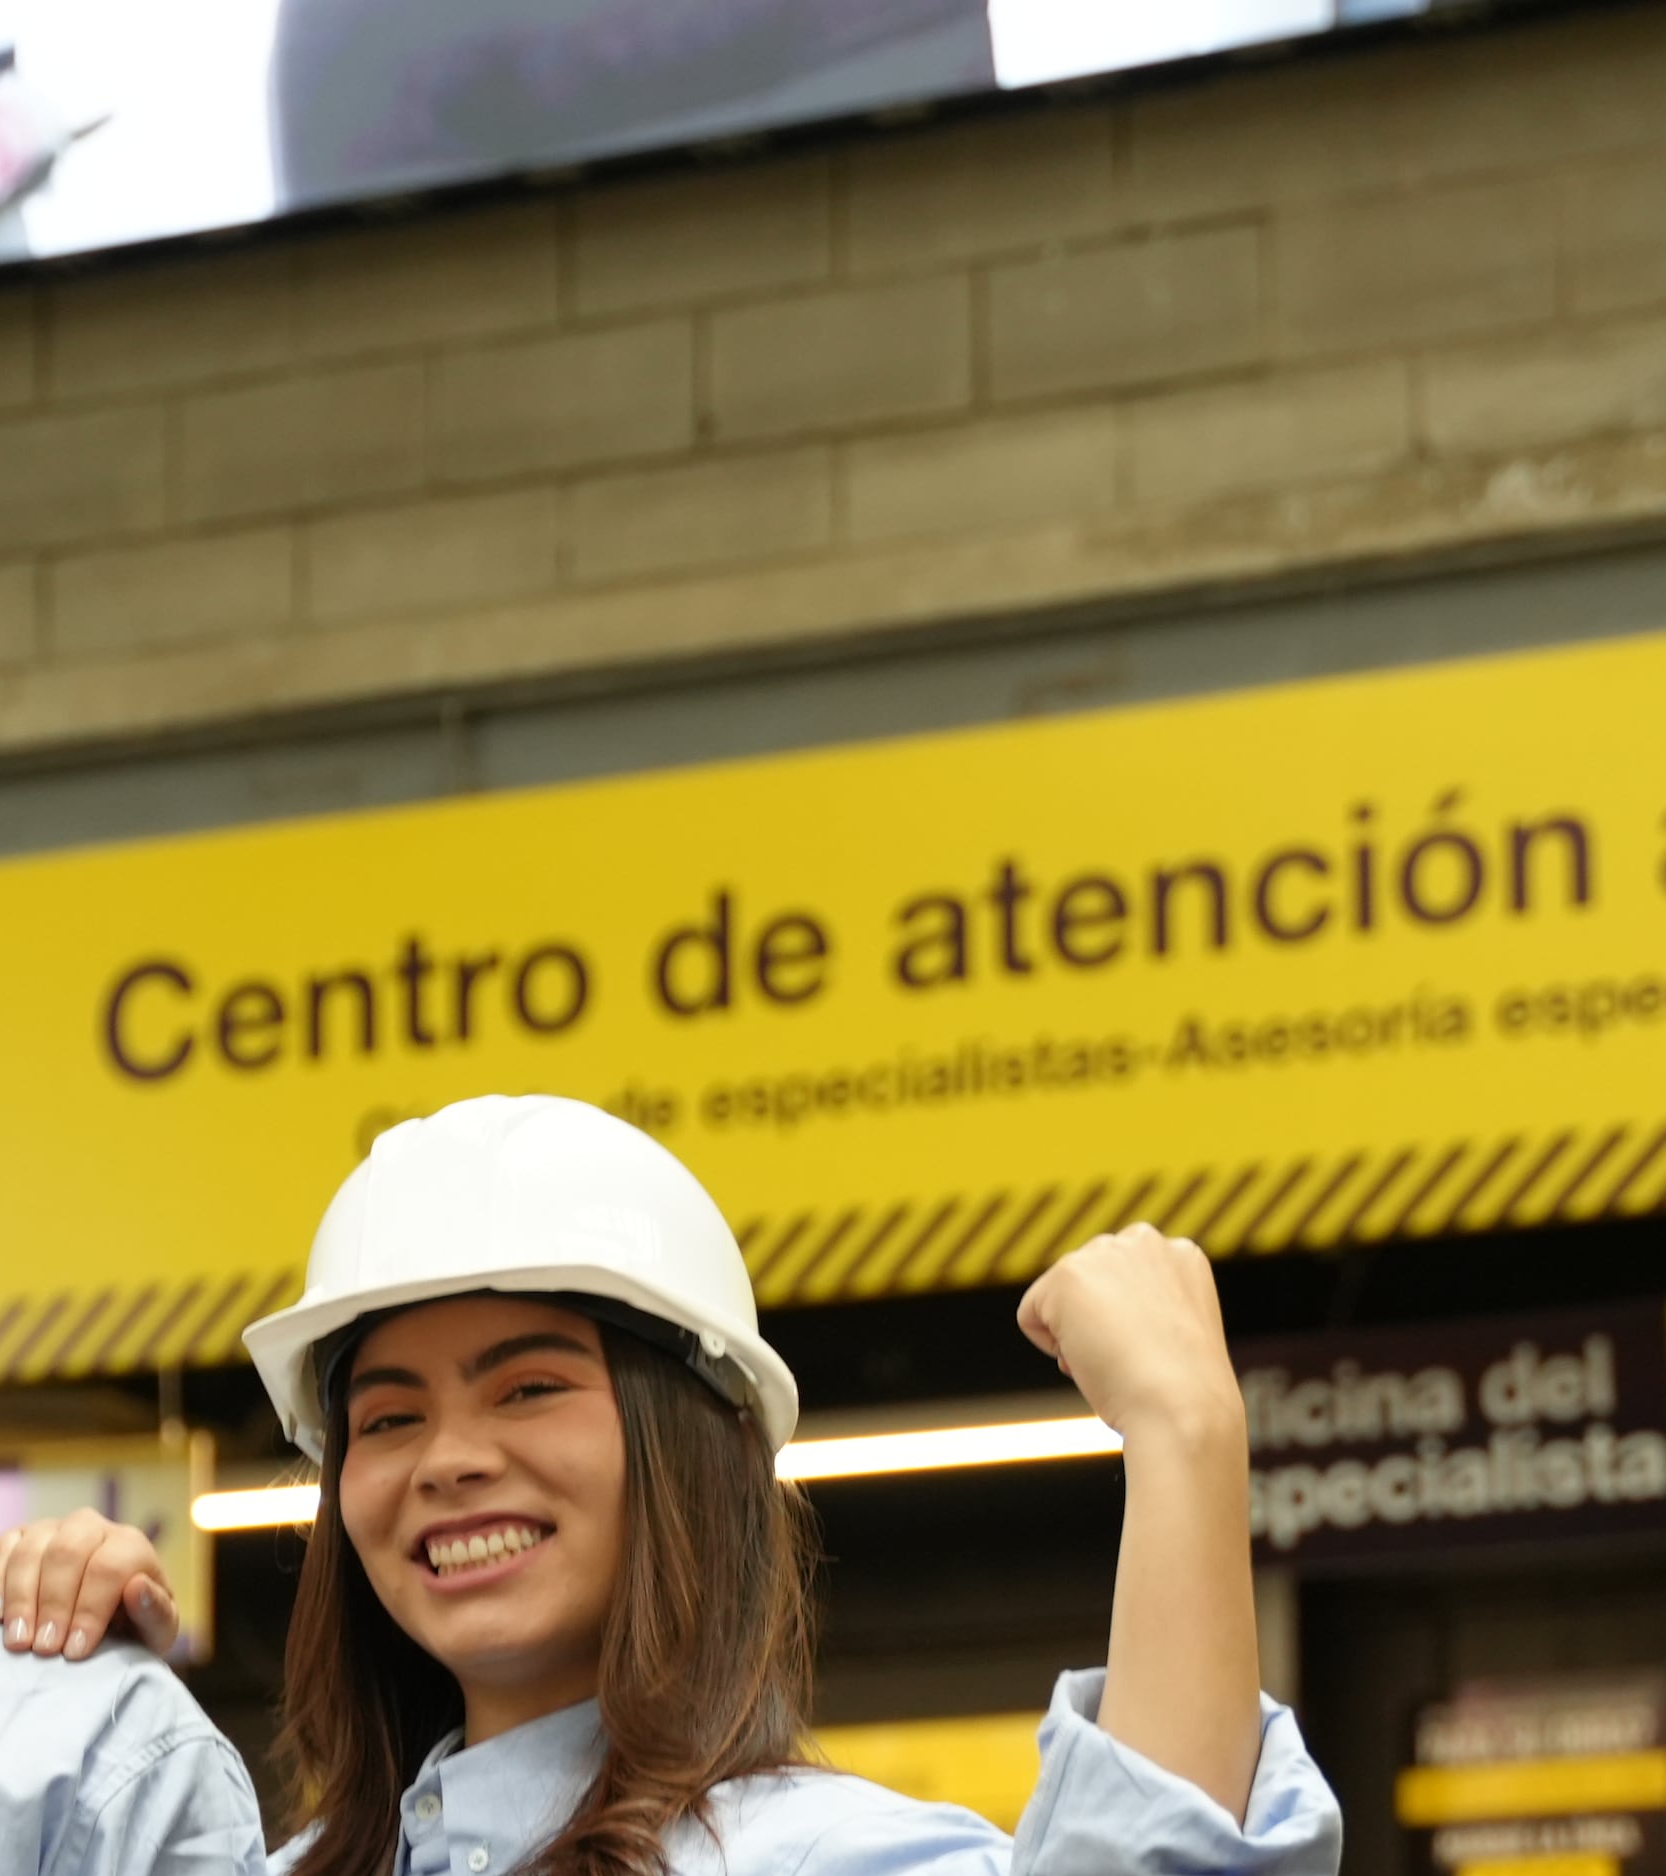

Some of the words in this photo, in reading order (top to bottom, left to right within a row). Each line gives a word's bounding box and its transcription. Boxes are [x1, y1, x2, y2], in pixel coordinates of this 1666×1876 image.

[101, 930, 593, 1084] Centro
[649, 886, 831, 1020] de
[889, 786, 1596, 994] atención
[1478, 1332, 1616, 1425] del
